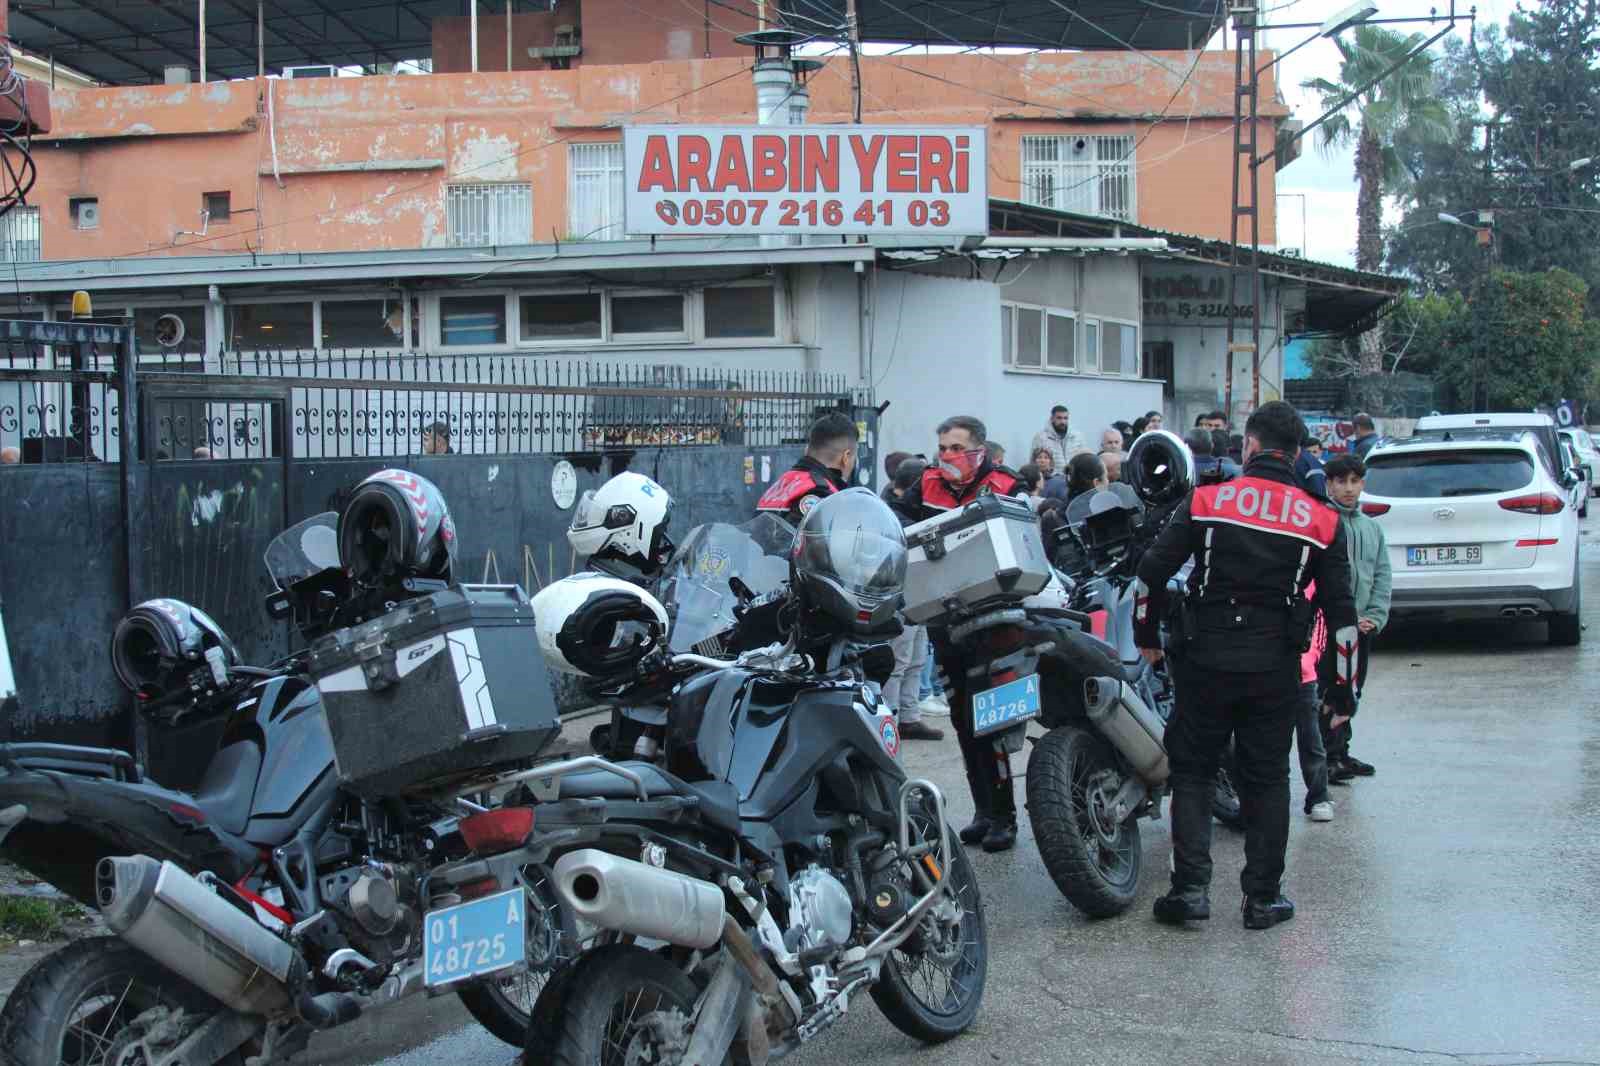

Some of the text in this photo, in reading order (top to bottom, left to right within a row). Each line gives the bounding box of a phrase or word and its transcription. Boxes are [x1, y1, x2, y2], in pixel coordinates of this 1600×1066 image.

[637, 134, 840, 193] ARABIN
[682, 199, 951, 226] 0507 216 41 03
[1213, 485, 1312, 528] POLİS
[1414, 548, 1427, 560] 01
[1466, 547, 1480, 560] 69
[977, 679, 1035, 710] 01 A
[978, 699, 1027, 728] 48726
[431, 897, 520, 945] 01 A
[431, 933, 505, 976] 48725
